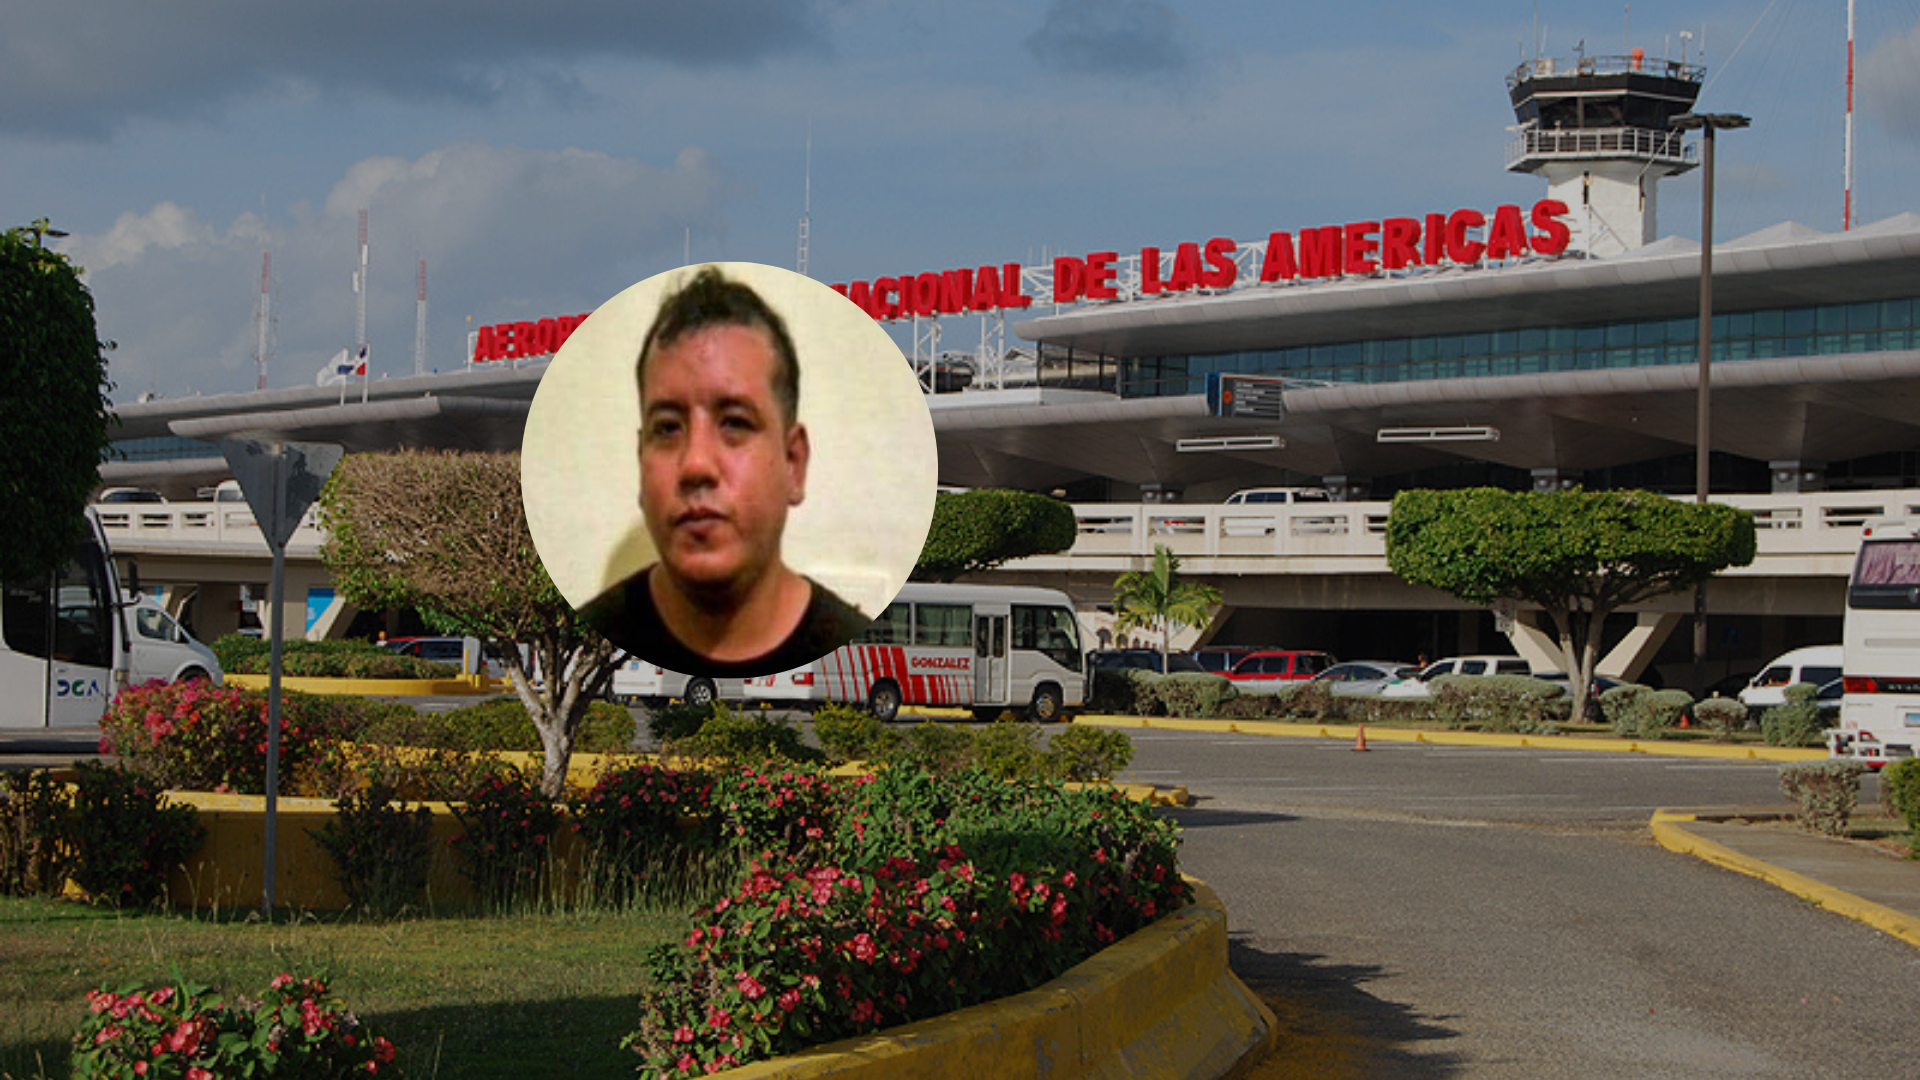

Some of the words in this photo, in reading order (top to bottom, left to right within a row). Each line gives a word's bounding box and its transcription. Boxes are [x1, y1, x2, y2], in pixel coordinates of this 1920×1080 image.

[473, 312, 593, 362] AEROP
[1053, 252, 1118, 303] DE
[1141, 237, 1237, 294] LAS
[1260, 199, 1571, 282] AMERICAS
[911, 656, 970, 670] GONZALEZ
